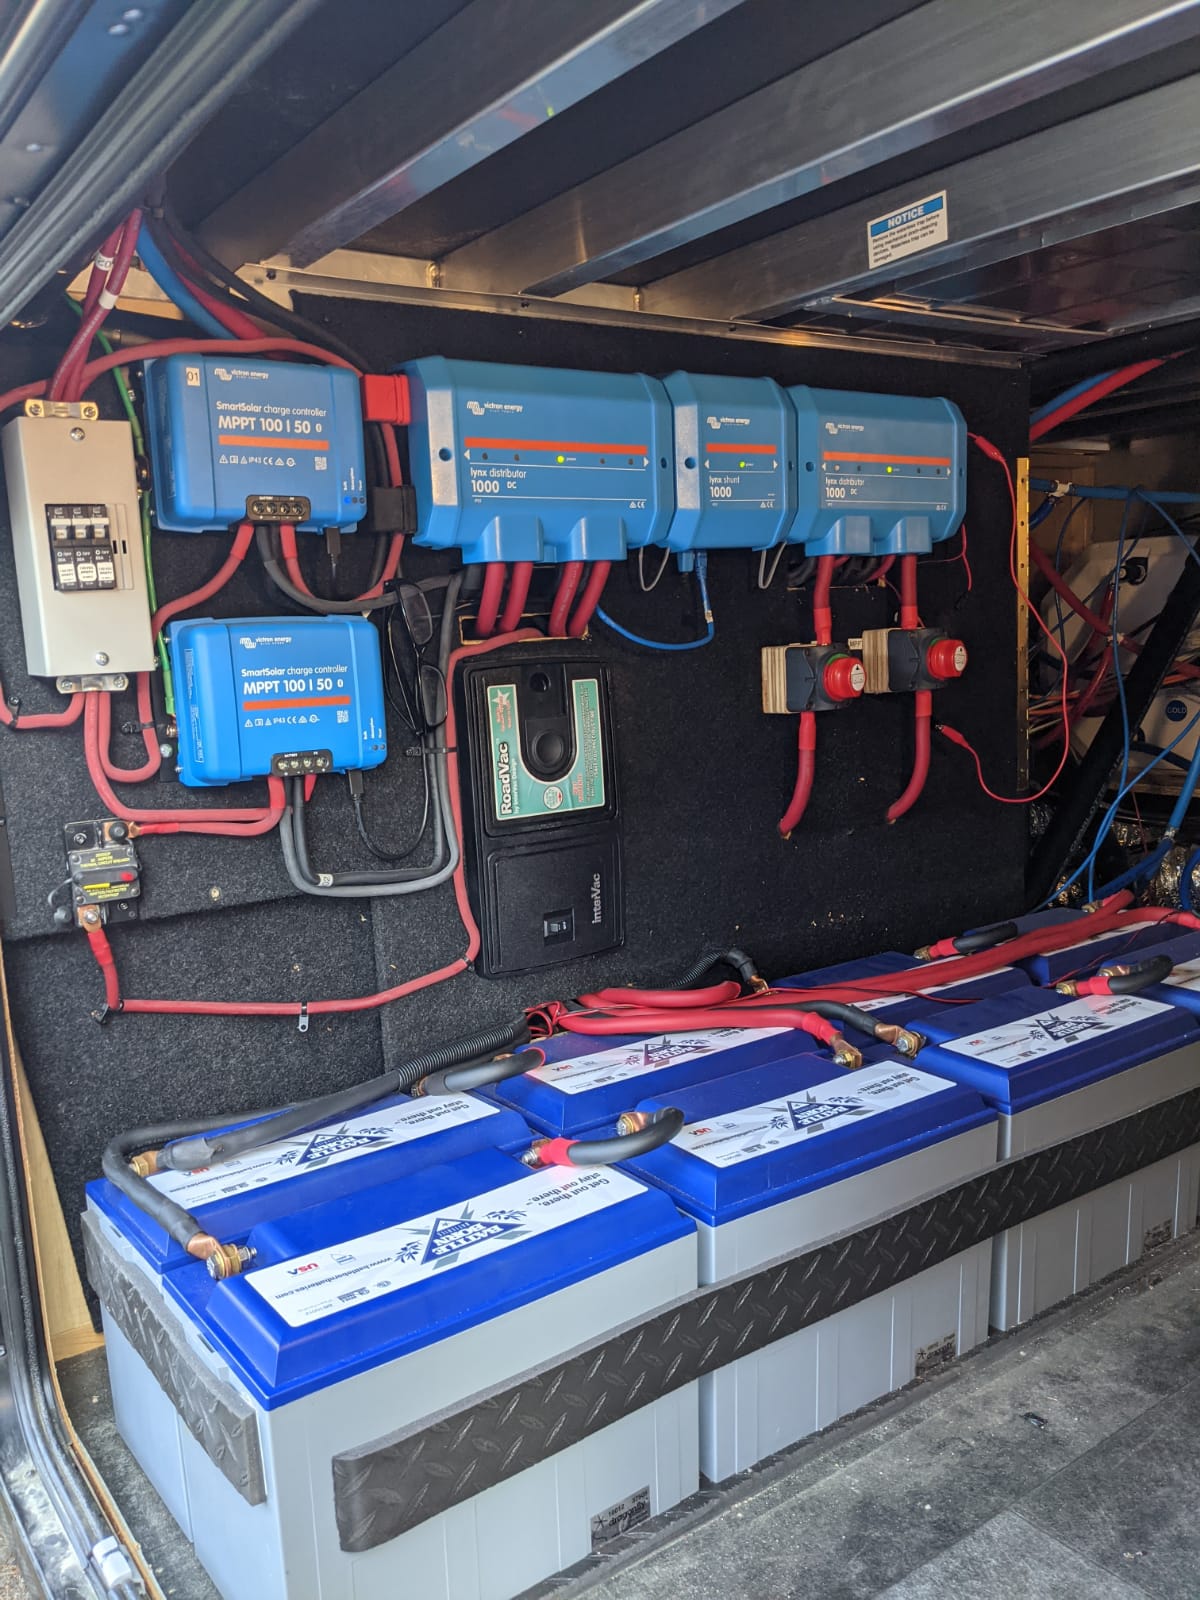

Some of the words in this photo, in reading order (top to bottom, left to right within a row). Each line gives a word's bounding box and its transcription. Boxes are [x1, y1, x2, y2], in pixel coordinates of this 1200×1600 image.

[888, 206, 925, 228] NOTICE
[187, 371, 199, 381] 01
[231, 369, 249, 377] victron
[250, 371, 269, 379] energy
[216, 400, 262, 413] SmartSolar
[263, 404, 291, 416] charge
[291, 406, 327, 417] controller
[504, 404, 523, 412] energy
[218, 415, 256, 430] MPPT
[260, 418, 283, 432] 100
[294, 420, 311, 434] 50
[470, 467, 487, 478] lynx
[489, 468, 527, 479] distributor
[471, 480, 499, 493] 1000
[506, 481, 517, 489] DC
[709, 475, 722, 485] lynx
[724, 475, 740, 484] shunt
[826, 477, 838, 487] lynx
[838, 478, 864, 486] distributor
[710, 486, 732, 498] 1000
[826, 488, 846, 498] 1000
[274, 636, 292, 644] energy
[241, 666, 286, 678] SmartSolar
[287, 666, 313, 676] charge
[314, 664, 348, 674] controller
[243, 680, 280, 695] MPPT
[283, 679, 306, 692] 100
[316, 678, 333, 691] 50
[498, 741, 513, 815] RoadVac
[795, 1105, 849, 1125] BATTLE
[304, 1137, 371, 1159] BATTLE
[307, 1137, 357, 1152] BORN
[576, 1172, 602, 1183] stay
[587, 1177, 610, 1188] Get
[559, 1181, 579, 1191] out
[569, 1185, 591, 1195] out
[537, 1192, 574, 1208] there,
[429, 1224, 504, 1256] BATTLE
[431, 1222, 486, 1245] BORN
[285, 1261, 320, 1276] USA
[272, 1256, 394, 1301] www.battlebornbatteries.com
